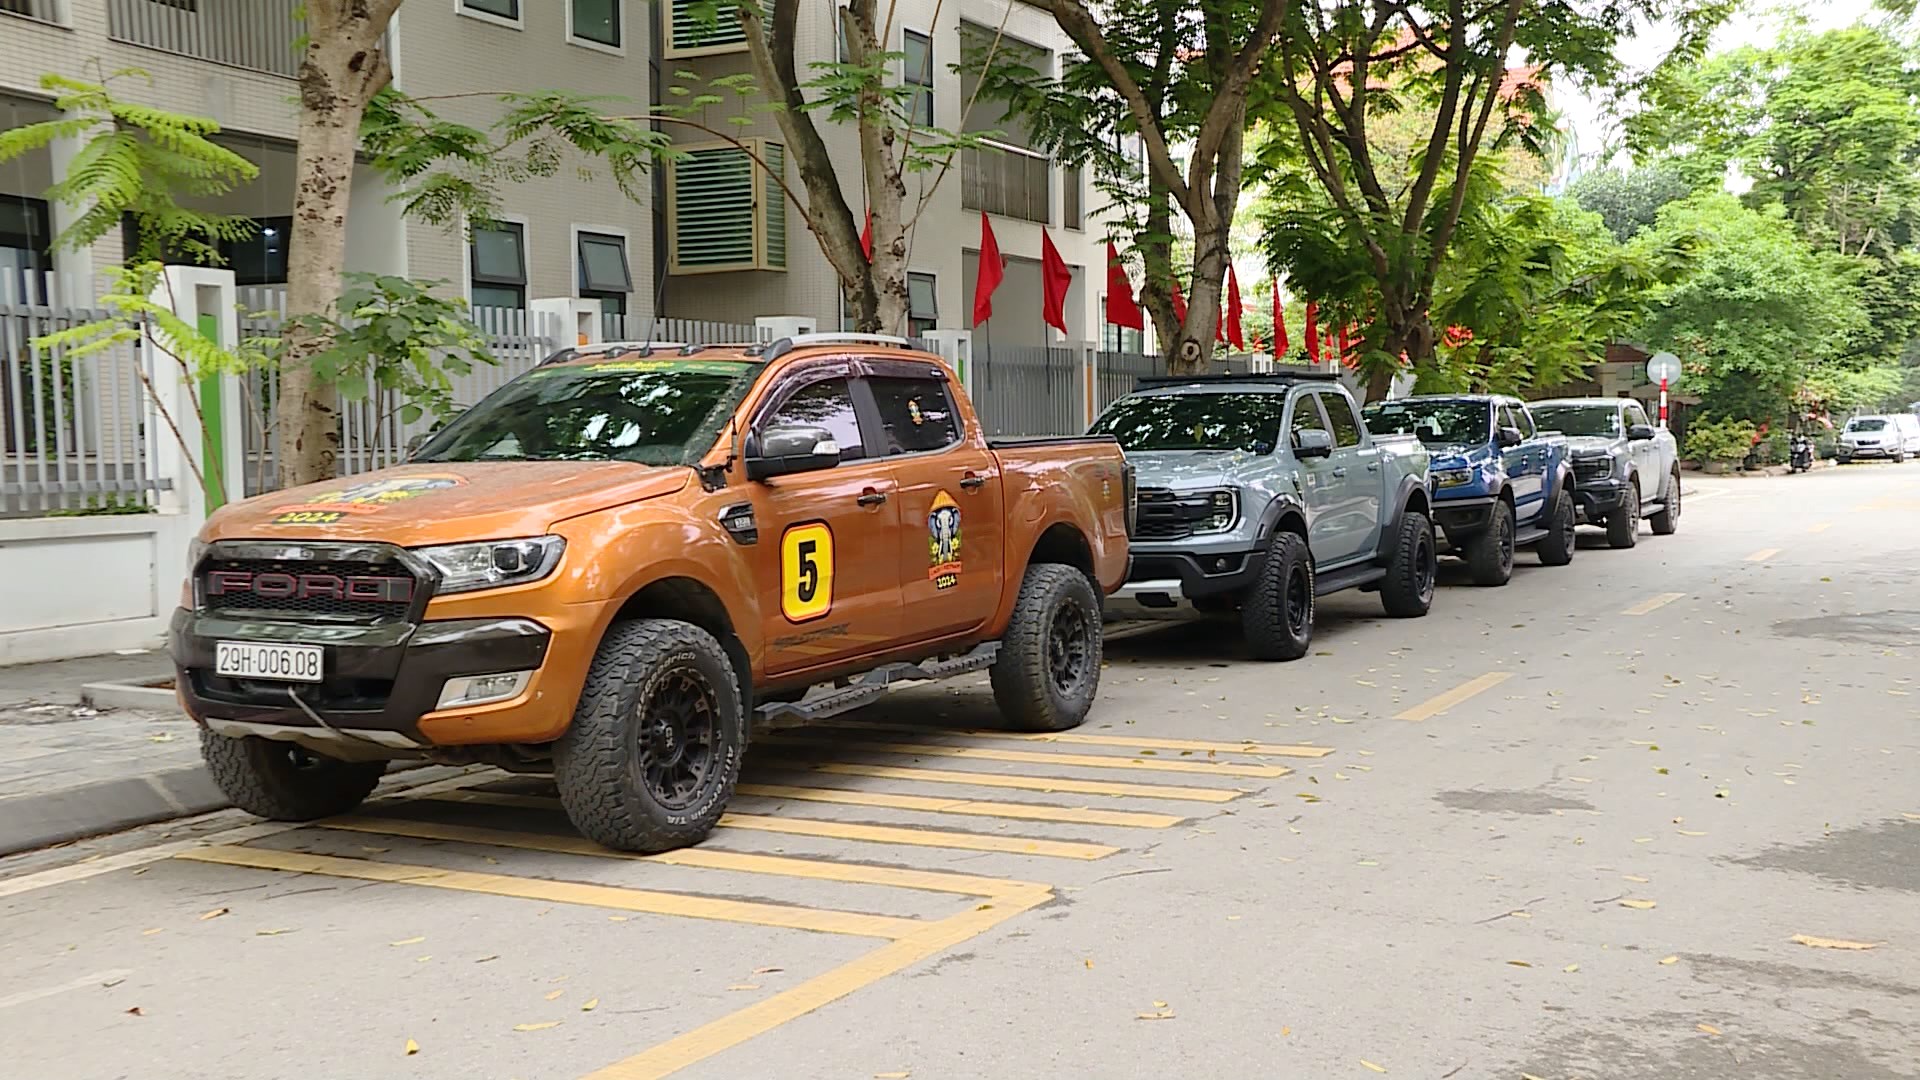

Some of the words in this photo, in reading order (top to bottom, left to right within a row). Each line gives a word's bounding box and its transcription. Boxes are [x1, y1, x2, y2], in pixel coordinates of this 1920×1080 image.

[277, 512, 340, 523] 2024
[208, 571, 414, 603] FORD
[798, 540, 818, 602] 5
